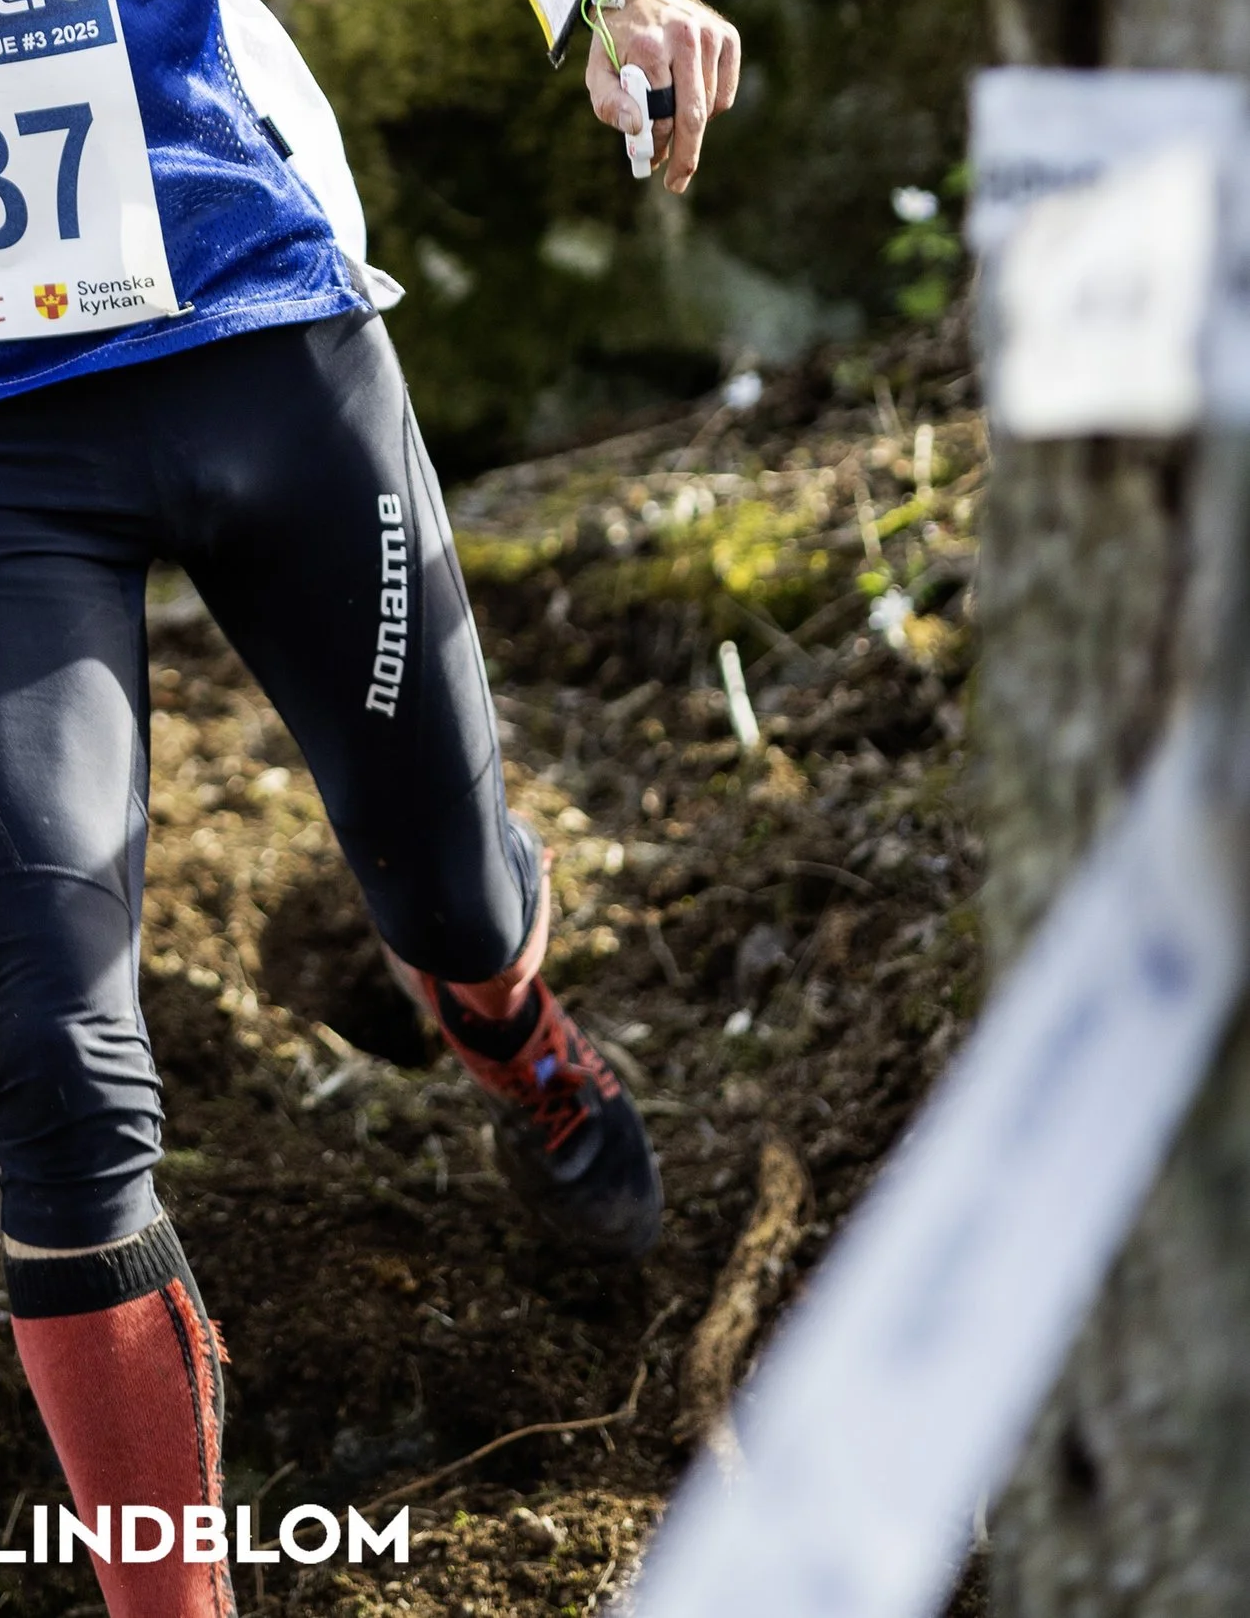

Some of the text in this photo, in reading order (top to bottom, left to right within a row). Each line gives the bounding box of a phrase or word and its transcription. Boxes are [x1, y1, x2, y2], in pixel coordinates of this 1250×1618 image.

[22, 31, 48, 52] #3
[51, 19, 99, 45] 2025
[77, 275, 155, 296] Svenska
[79, 294, 145, 317] kyrkan
[365, 493, 408, 719] noname
